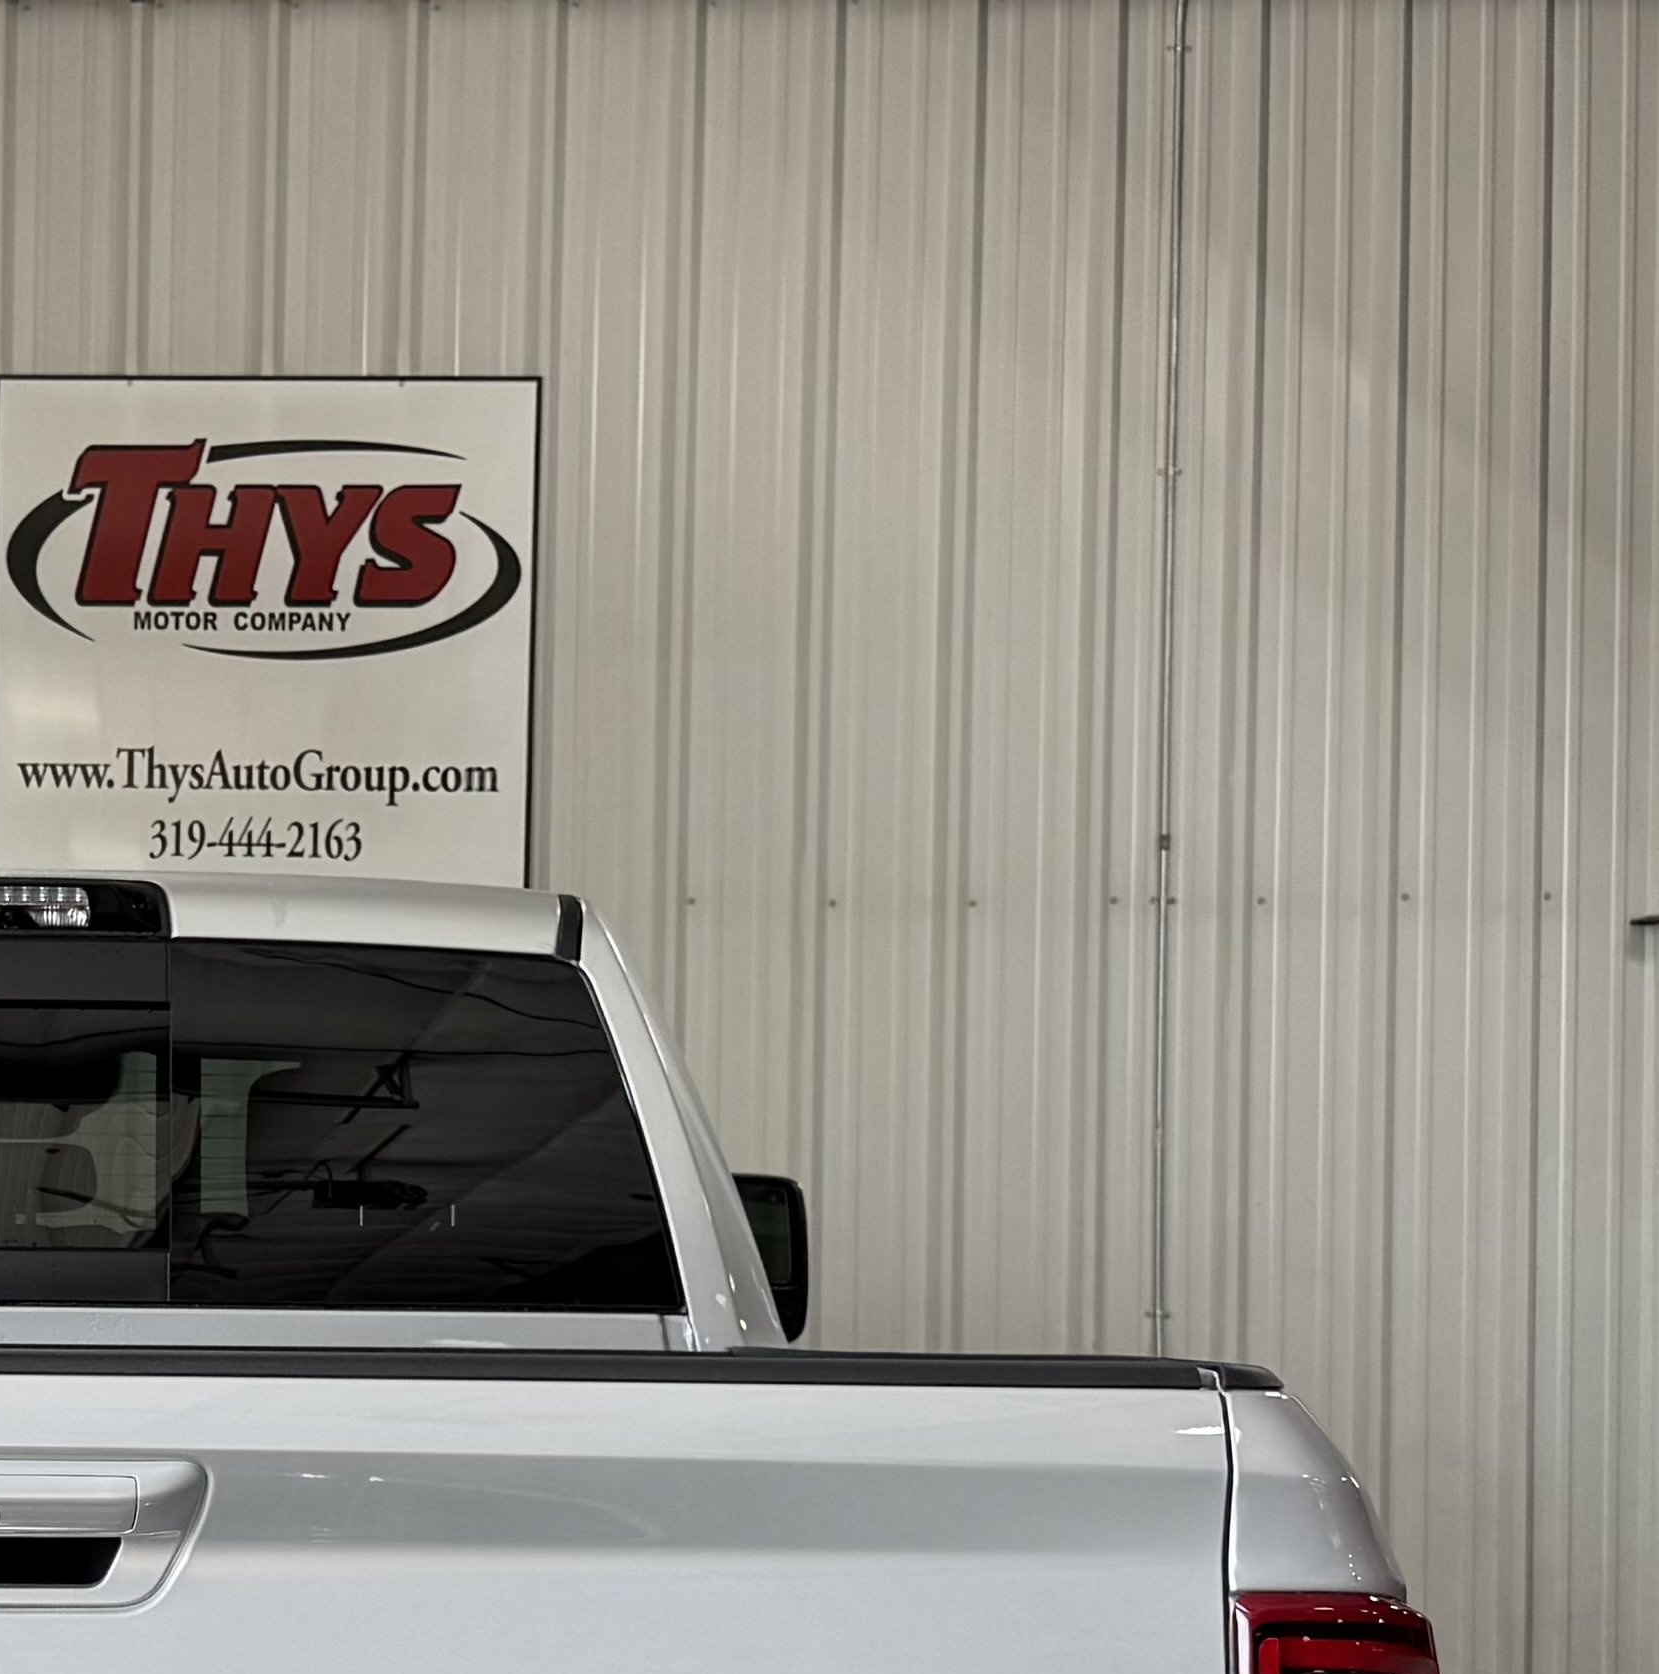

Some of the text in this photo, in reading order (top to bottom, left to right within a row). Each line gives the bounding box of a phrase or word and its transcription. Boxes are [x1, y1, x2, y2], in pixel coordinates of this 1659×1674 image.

[65, 438, 463, 608] THYS
[133, 611, 351, 633] MOTOR COMPANY
[17, 745, 500, 806] www.ThysAutoGroup.com
[148, 816, 363, 862] 319-444-2163
